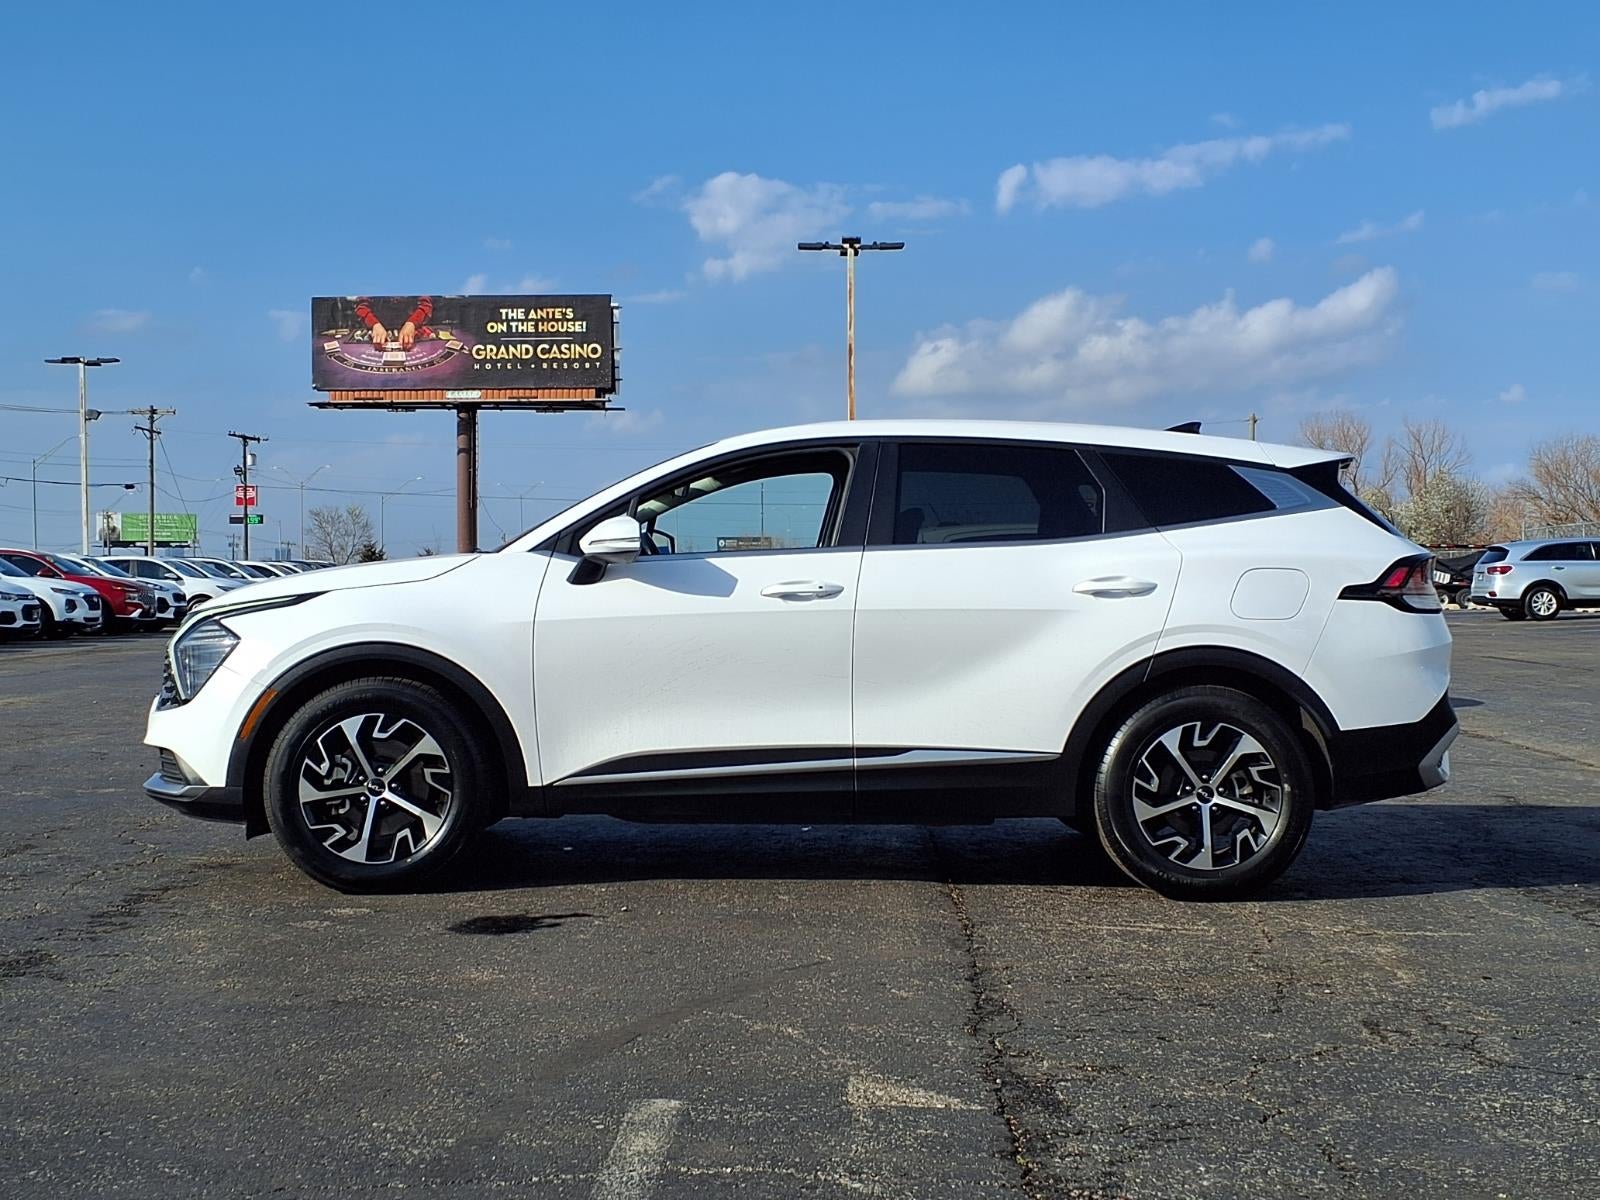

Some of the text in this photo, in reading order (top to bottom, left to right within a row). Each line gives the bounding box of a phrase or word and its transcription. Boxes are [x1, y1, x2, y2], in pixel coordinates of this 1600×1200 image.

[500, 308, 574, 320] THE ANTE'S
[486, 321, 587, 333] ON THE HOUSE!
[472, 343, 602, 360] GRAND CASINO
[474, 362, 522, 370] HOTEL
